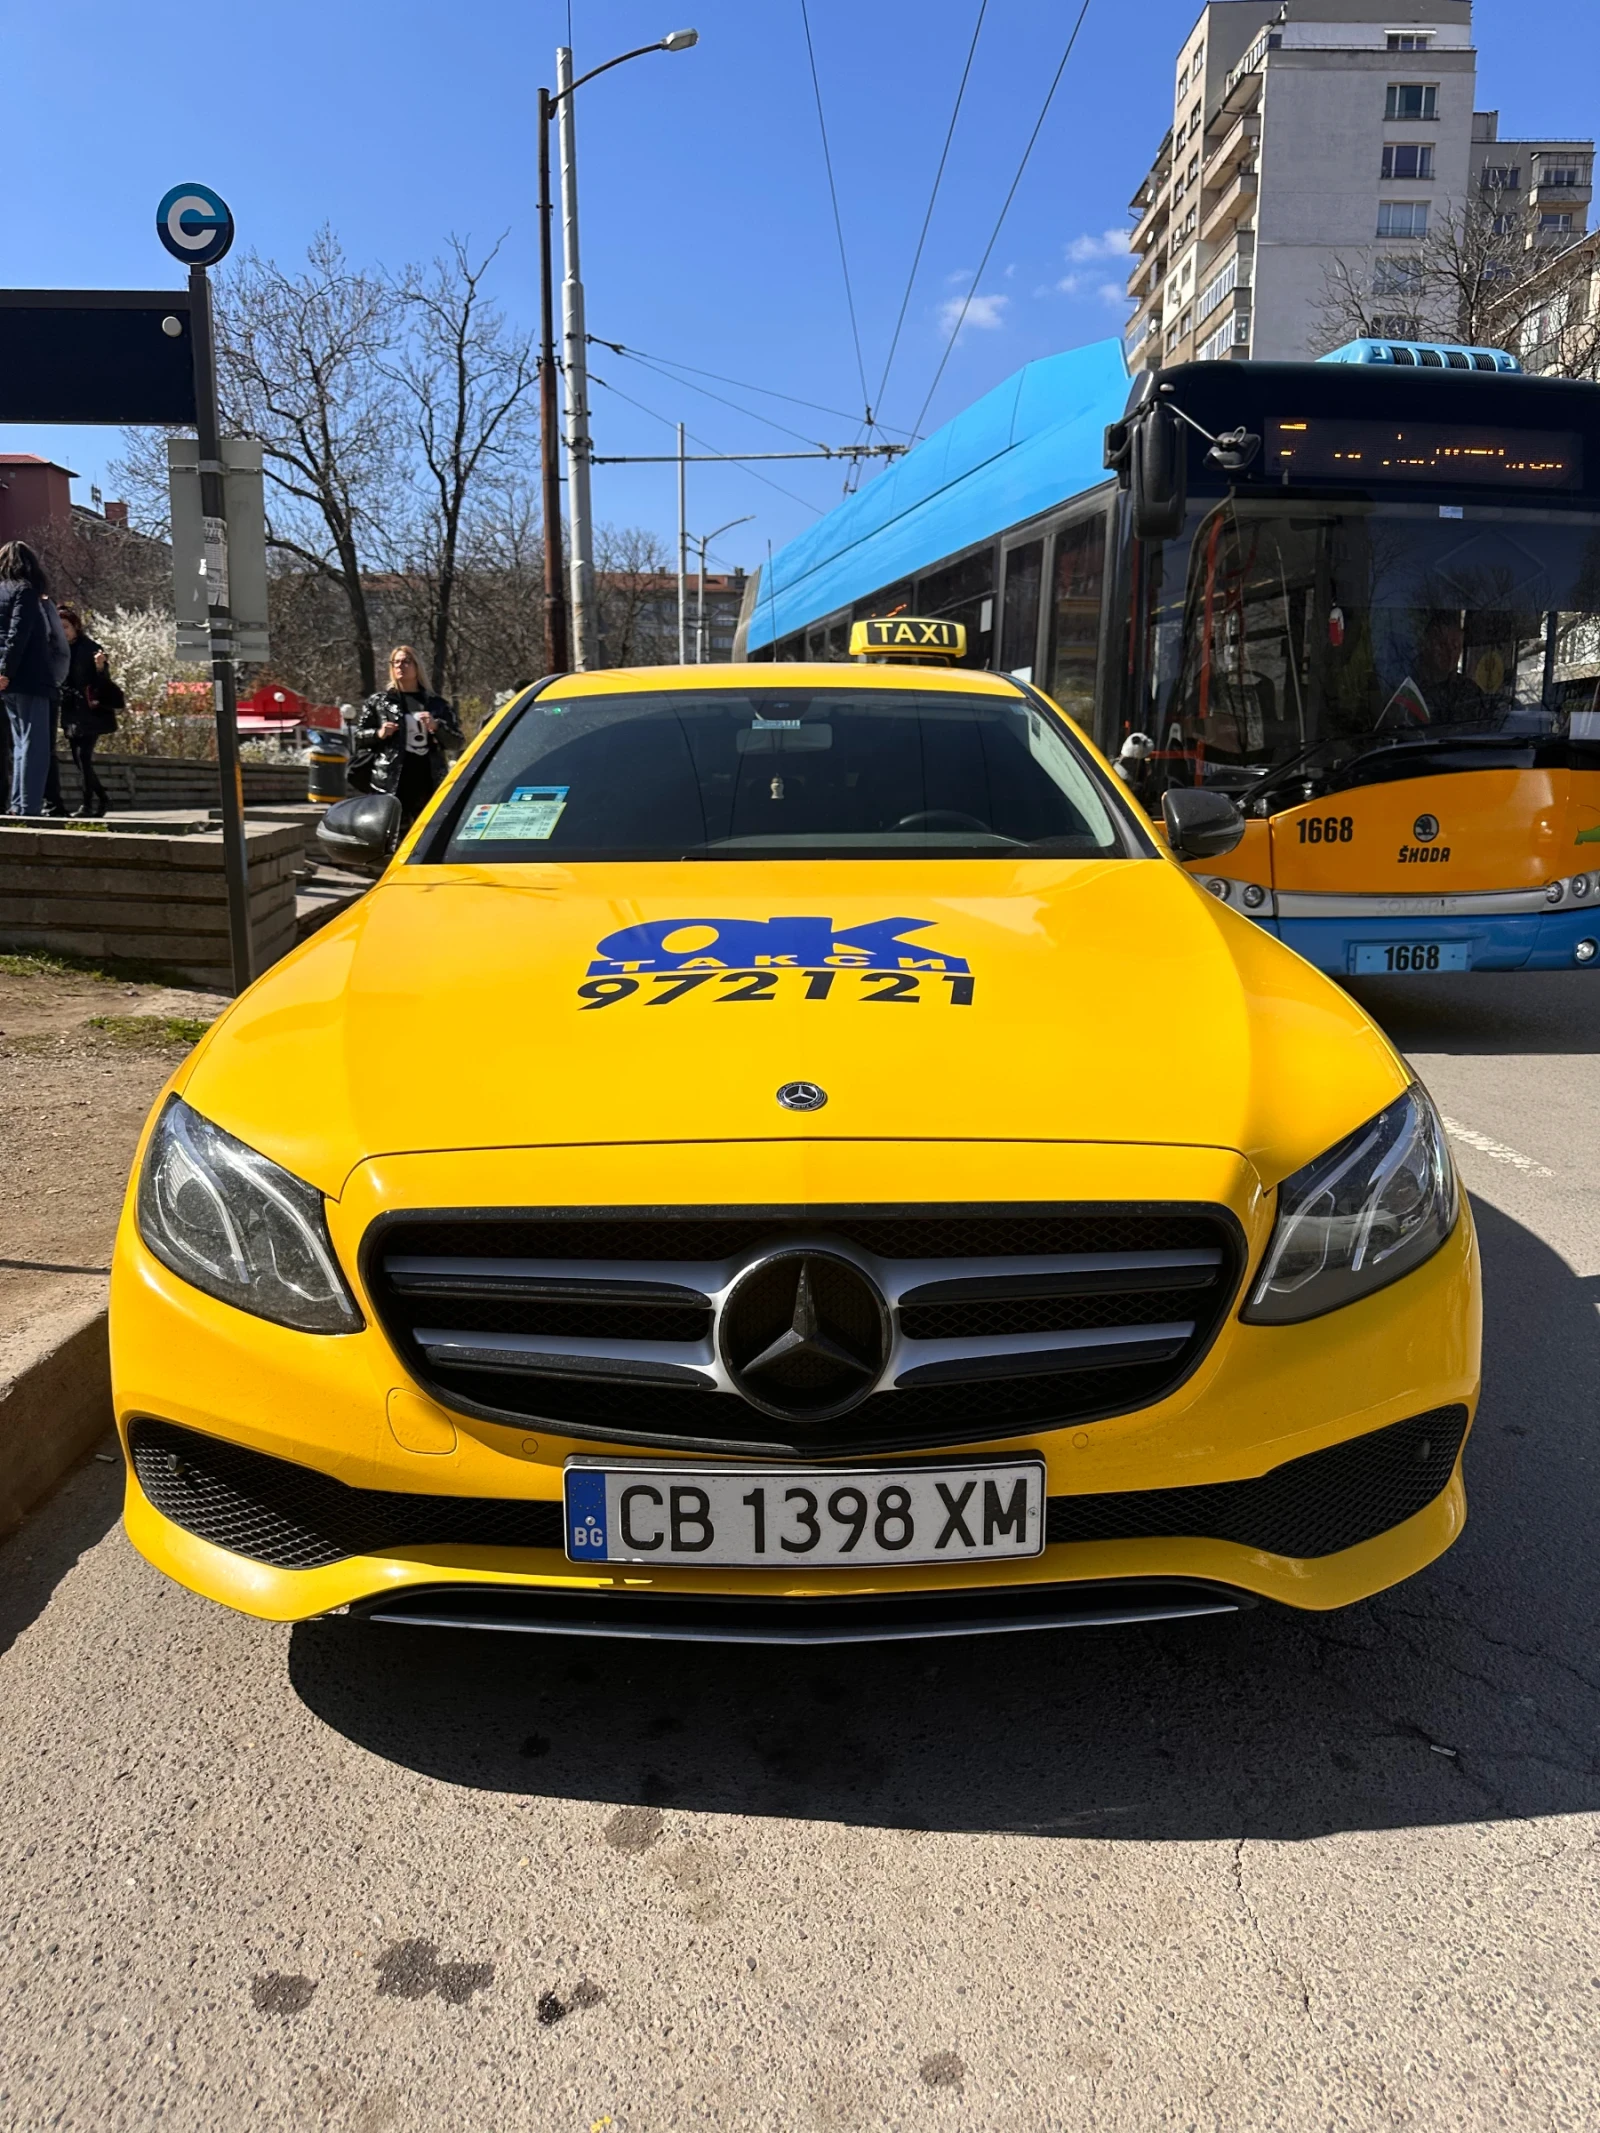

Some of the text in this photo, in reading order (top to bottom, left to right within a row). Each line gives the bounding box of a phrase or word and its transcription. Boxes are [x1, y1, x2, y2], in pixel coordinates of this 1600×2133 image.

[874, 623, 949, 644] TAXI
[1296, 816, 1353, 844] 1668
[1397, 845, 1451, 863] ŠKODA
[1376, 899, 1457, 914] SOLARIS
[610, 955, 948, 972] ТАКСИ
[1384, 945, 1440, 971] 1668
[577, 971, 976, 1011] 972121
[620, 1478, 1027, 1553] CB 1398 XM
[574, 1526, 604, 1548] BG
